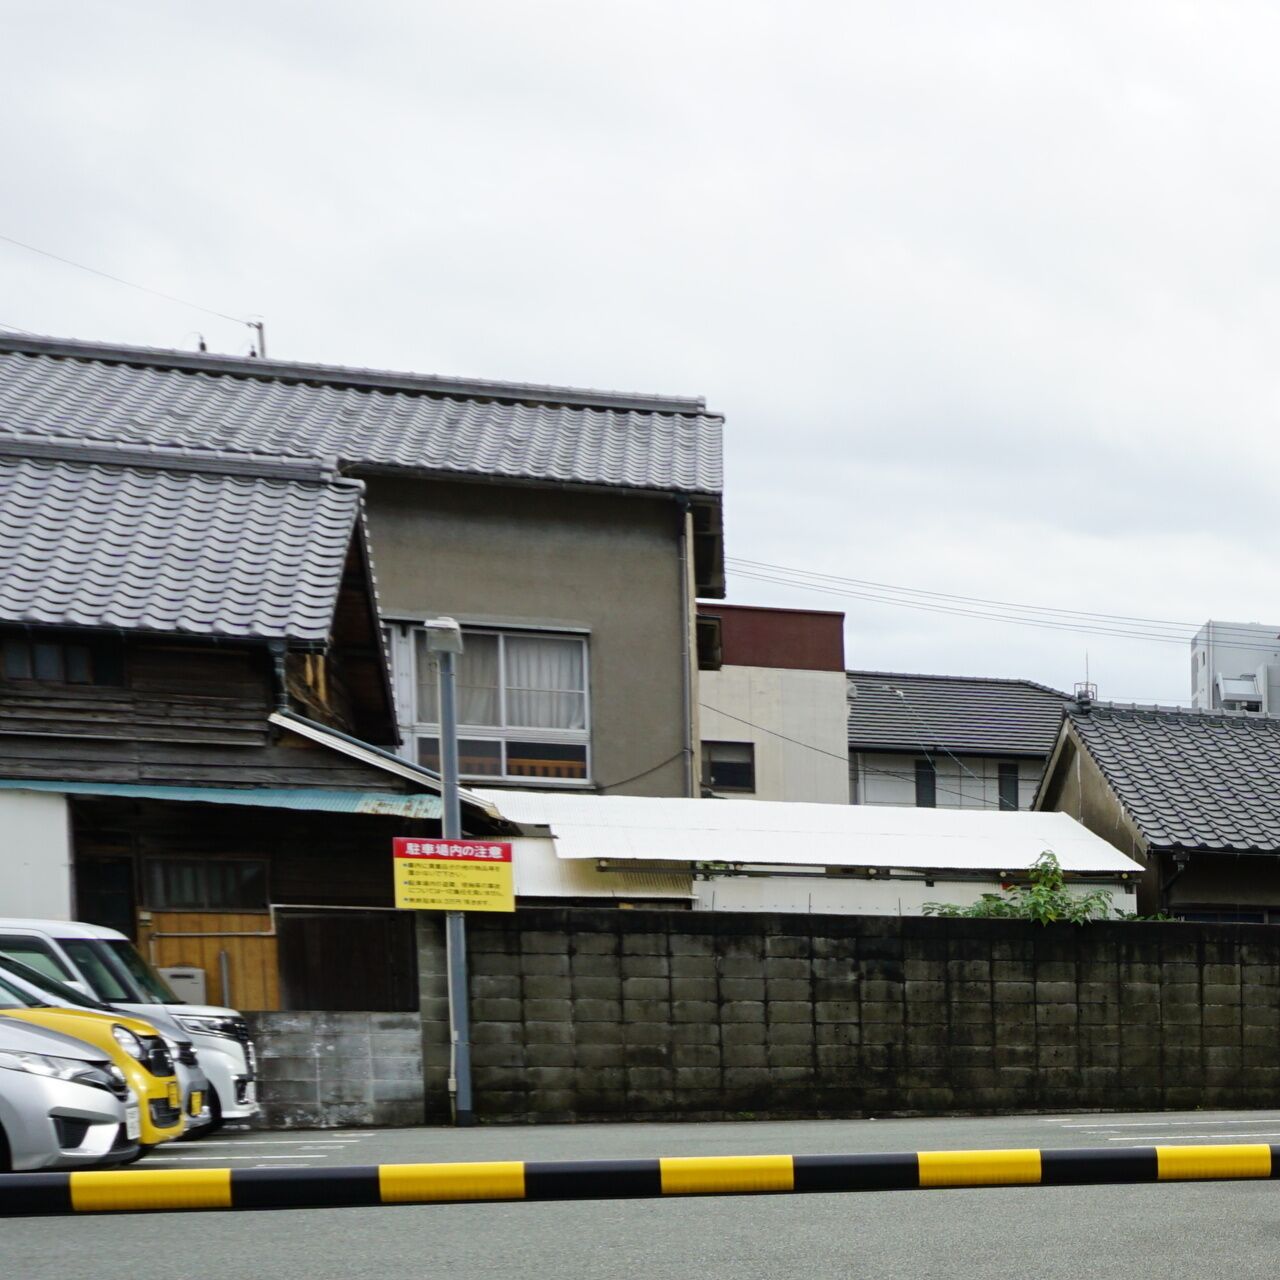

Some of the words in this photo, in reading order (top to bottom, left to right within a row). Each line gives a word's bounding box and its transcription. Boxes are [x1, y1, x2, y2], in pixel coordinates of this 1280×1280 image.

[405, 842, 503, 859] 駐車場内の注意
